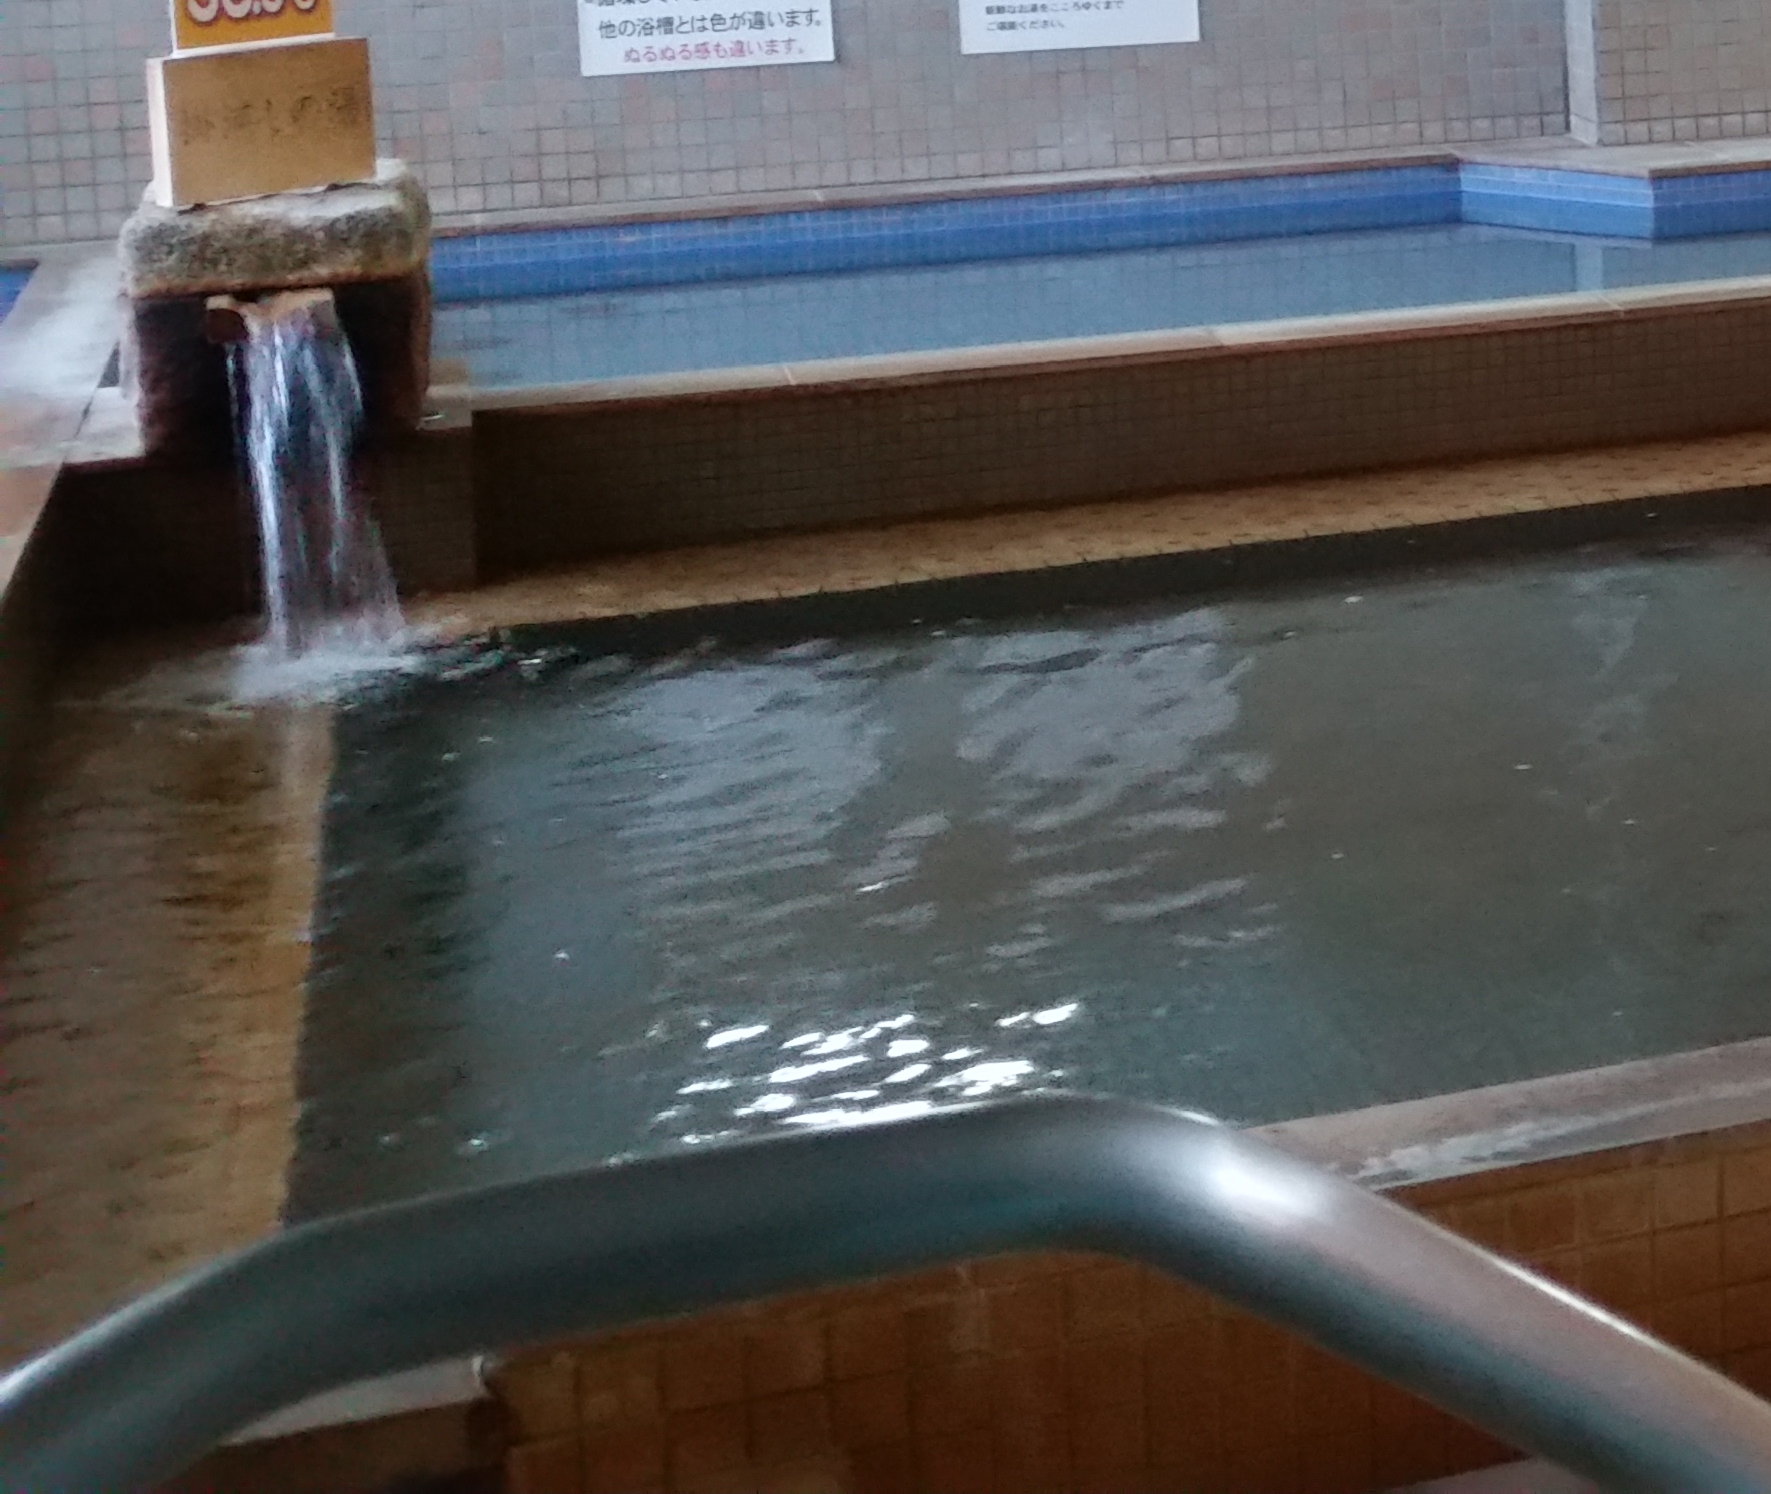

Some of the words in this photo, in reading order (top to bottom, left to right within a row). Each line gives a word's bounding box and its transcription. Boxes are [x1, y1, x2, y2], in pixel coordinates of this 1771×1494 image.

[598, 8, 822, 40] 他の浴槽とは色が違います。
[623, 37, 805, 64] ぬるぬる感も違います。
